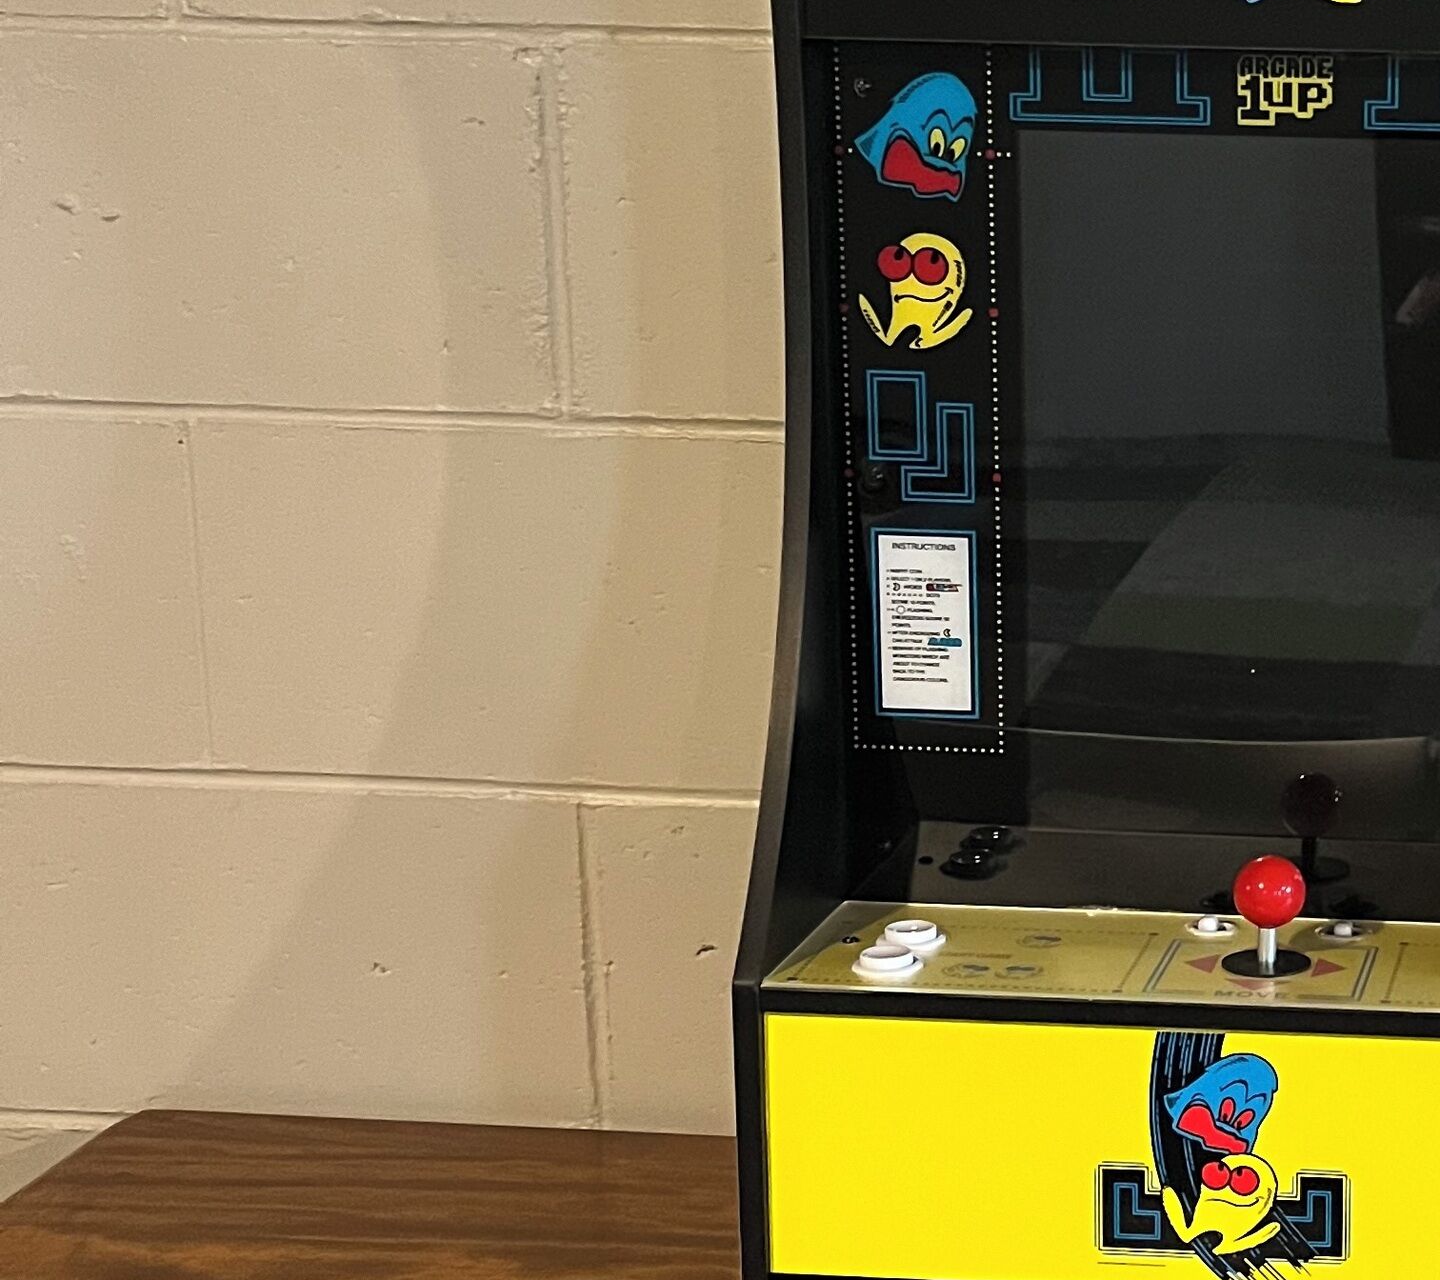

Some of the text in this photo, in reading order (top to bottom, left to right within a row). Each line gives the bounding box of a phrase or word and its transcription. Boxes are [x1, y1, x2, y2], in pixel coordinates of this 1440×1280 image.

[1237, 54, 1333, 80] ARCADE
[1237, 75, 1333, 126] 1UP
[891, 542, 957, 552] INSTRUCTIONS
[1213, 990, 1290, 999] MOVE
